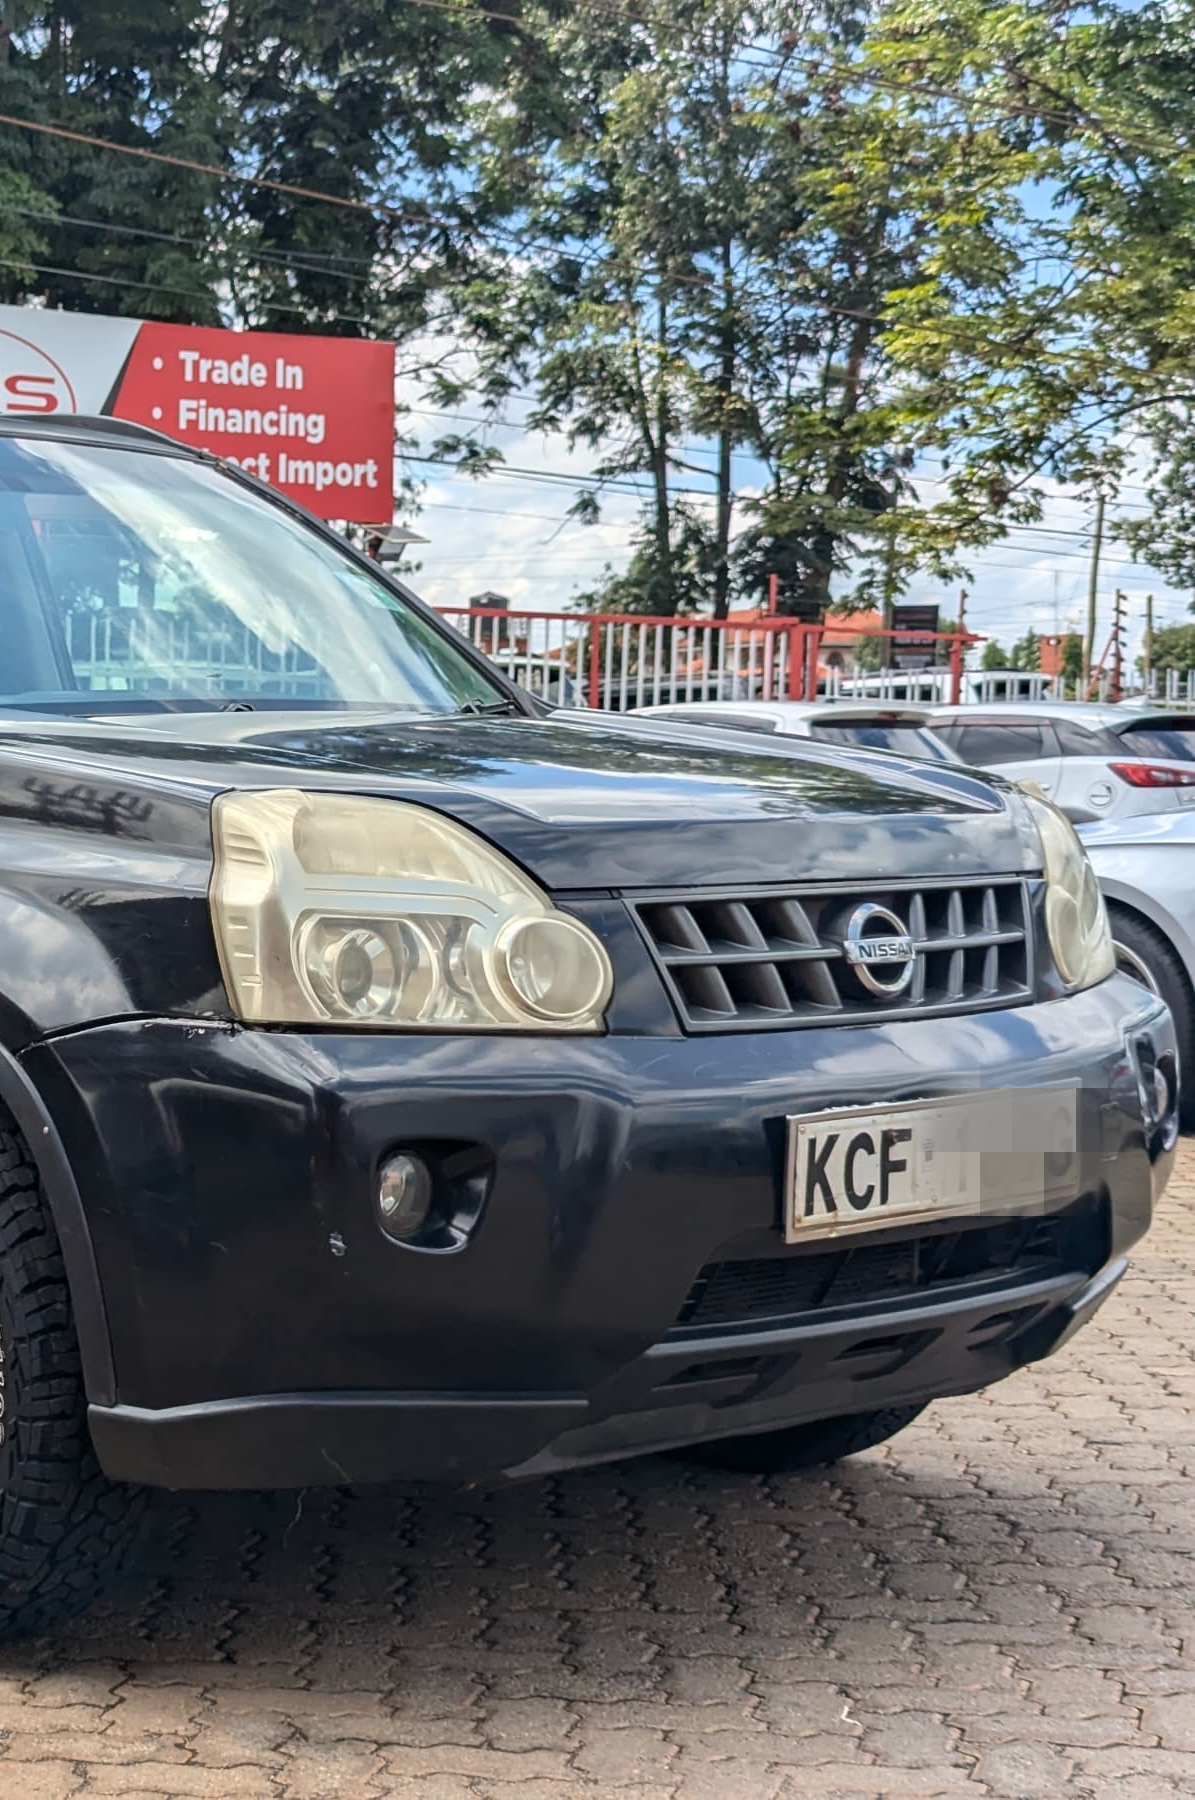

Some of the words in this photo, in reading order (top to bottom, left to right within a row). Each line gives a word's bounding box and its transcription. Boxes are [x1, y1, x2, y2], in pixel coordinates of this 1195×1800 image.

[178, 350, 268, 388] Trade
[275, 357, 304, 391] In
[178, 399, 326, 445] Financing
[278, 452, 379, 492] Import
[804, 1128, 913, 1217] KCF
